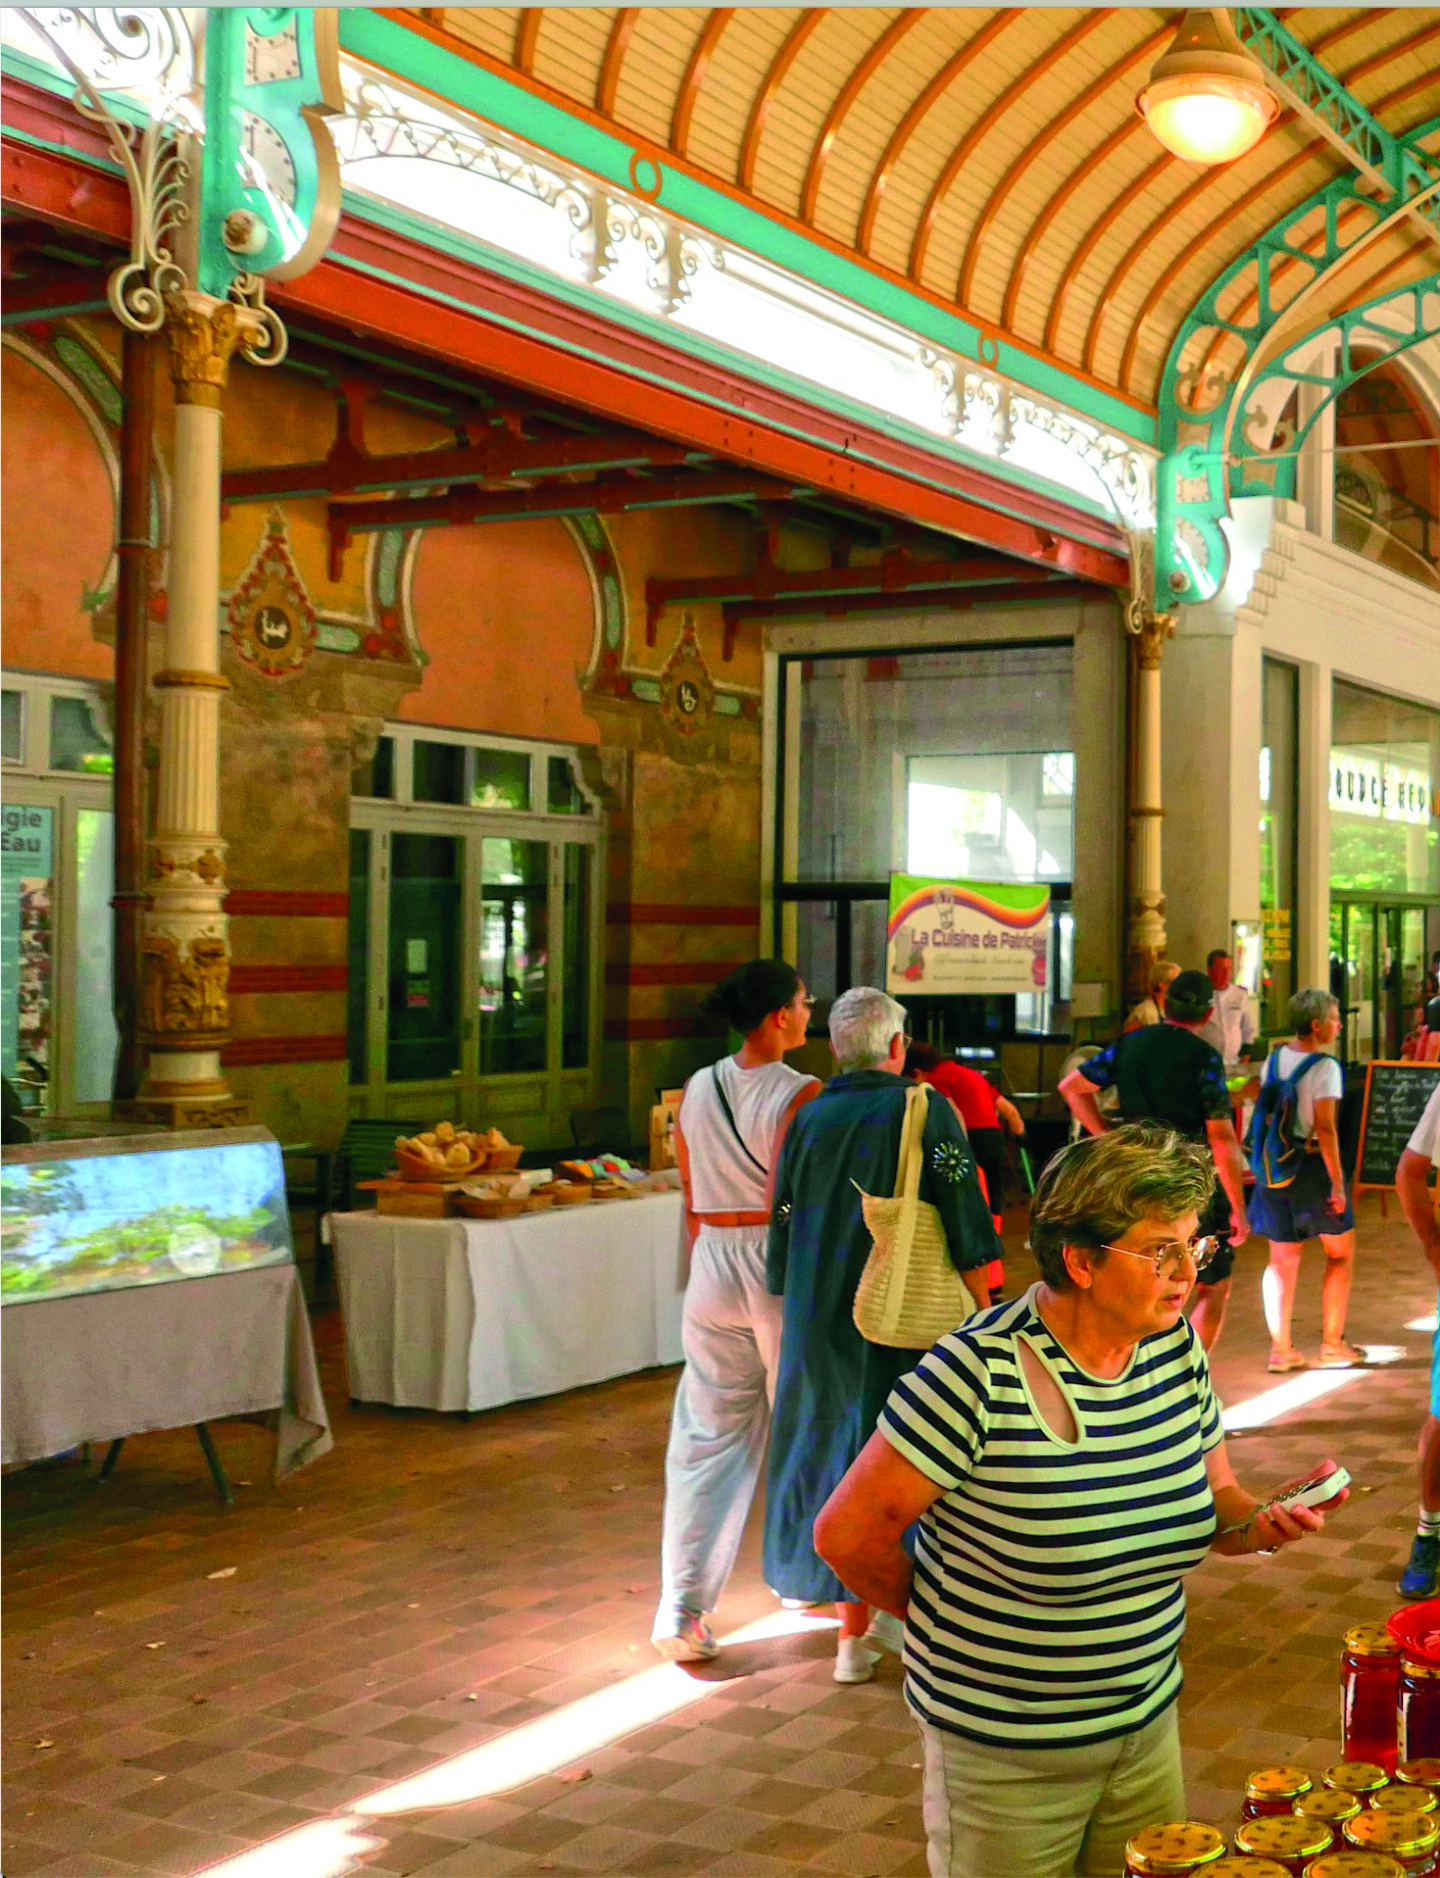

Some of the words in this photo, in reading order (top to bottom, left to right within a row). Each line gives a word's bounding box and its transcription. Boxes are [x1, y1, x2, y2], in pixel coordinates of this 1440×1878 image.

[911, 928, 930, 946] La
[931, 929, 980, 948] Cuisine
[982, 930, 998, 948] de
